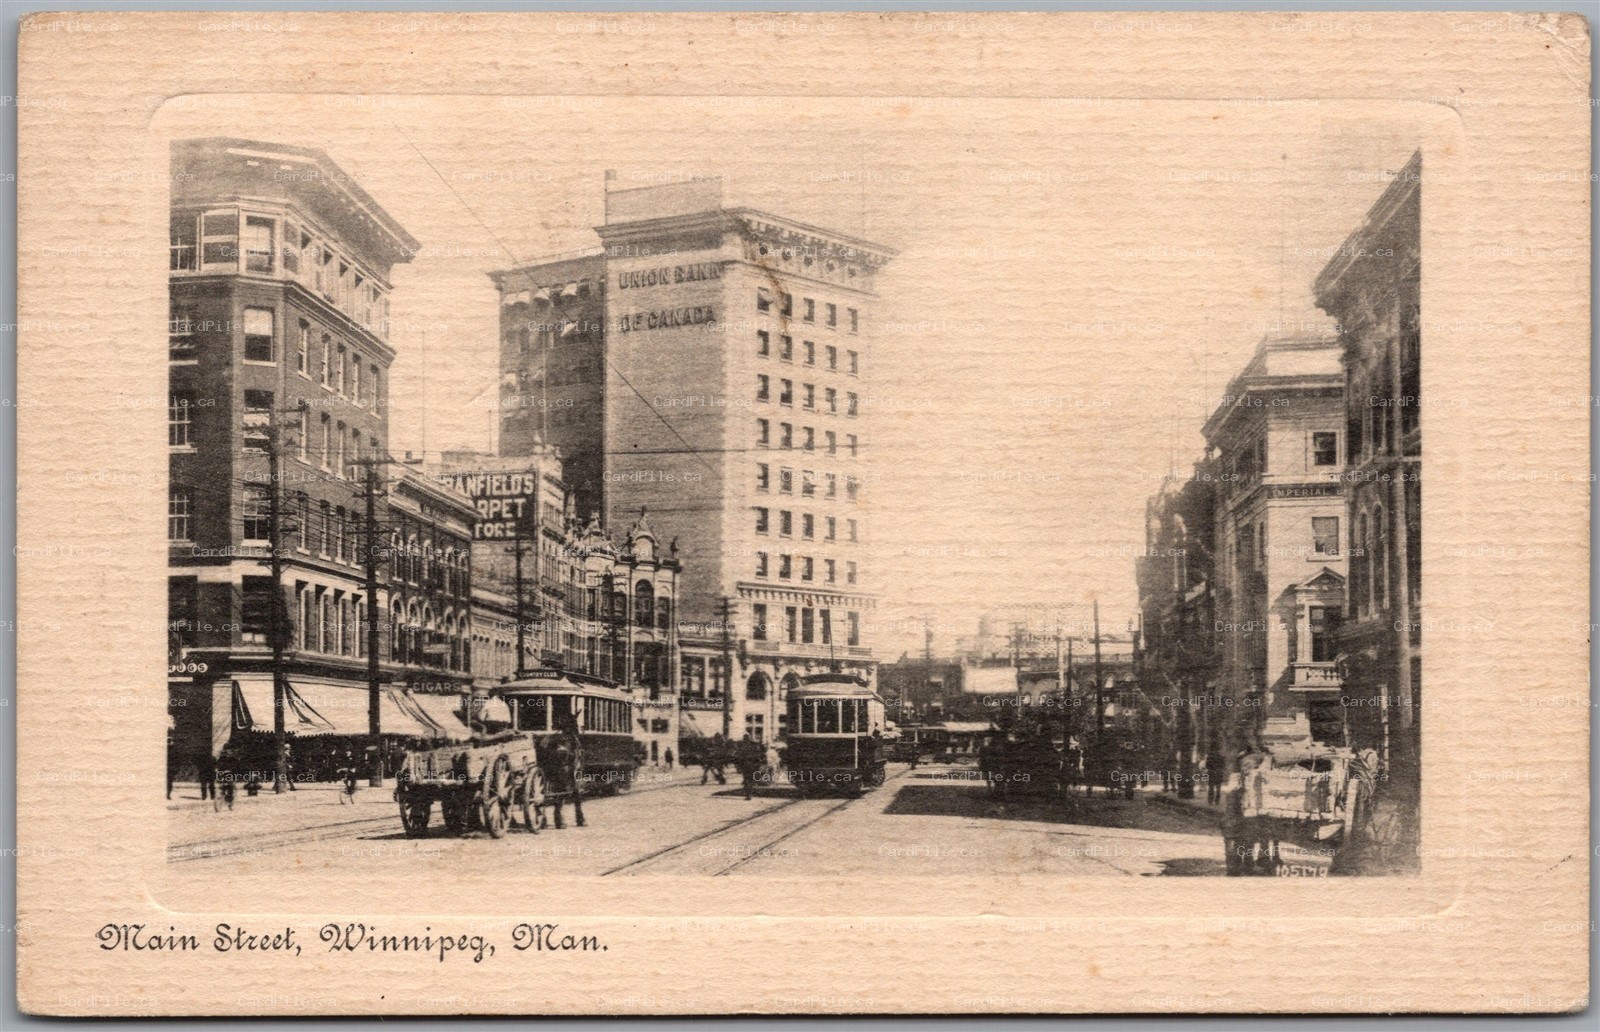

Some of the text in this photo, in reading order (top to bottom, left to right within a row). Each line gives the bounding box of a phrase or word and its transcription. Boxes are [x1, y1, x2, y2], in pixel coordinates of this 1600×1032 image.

[619, 266, 671, 290] UNION
[620, 305, 717, 334] OF CANADA
[1272, 487, 1329, 497] IMPERIAL
[470, 498, 527, 519] RPET
[413, 682, 460, 692] CIGARS
